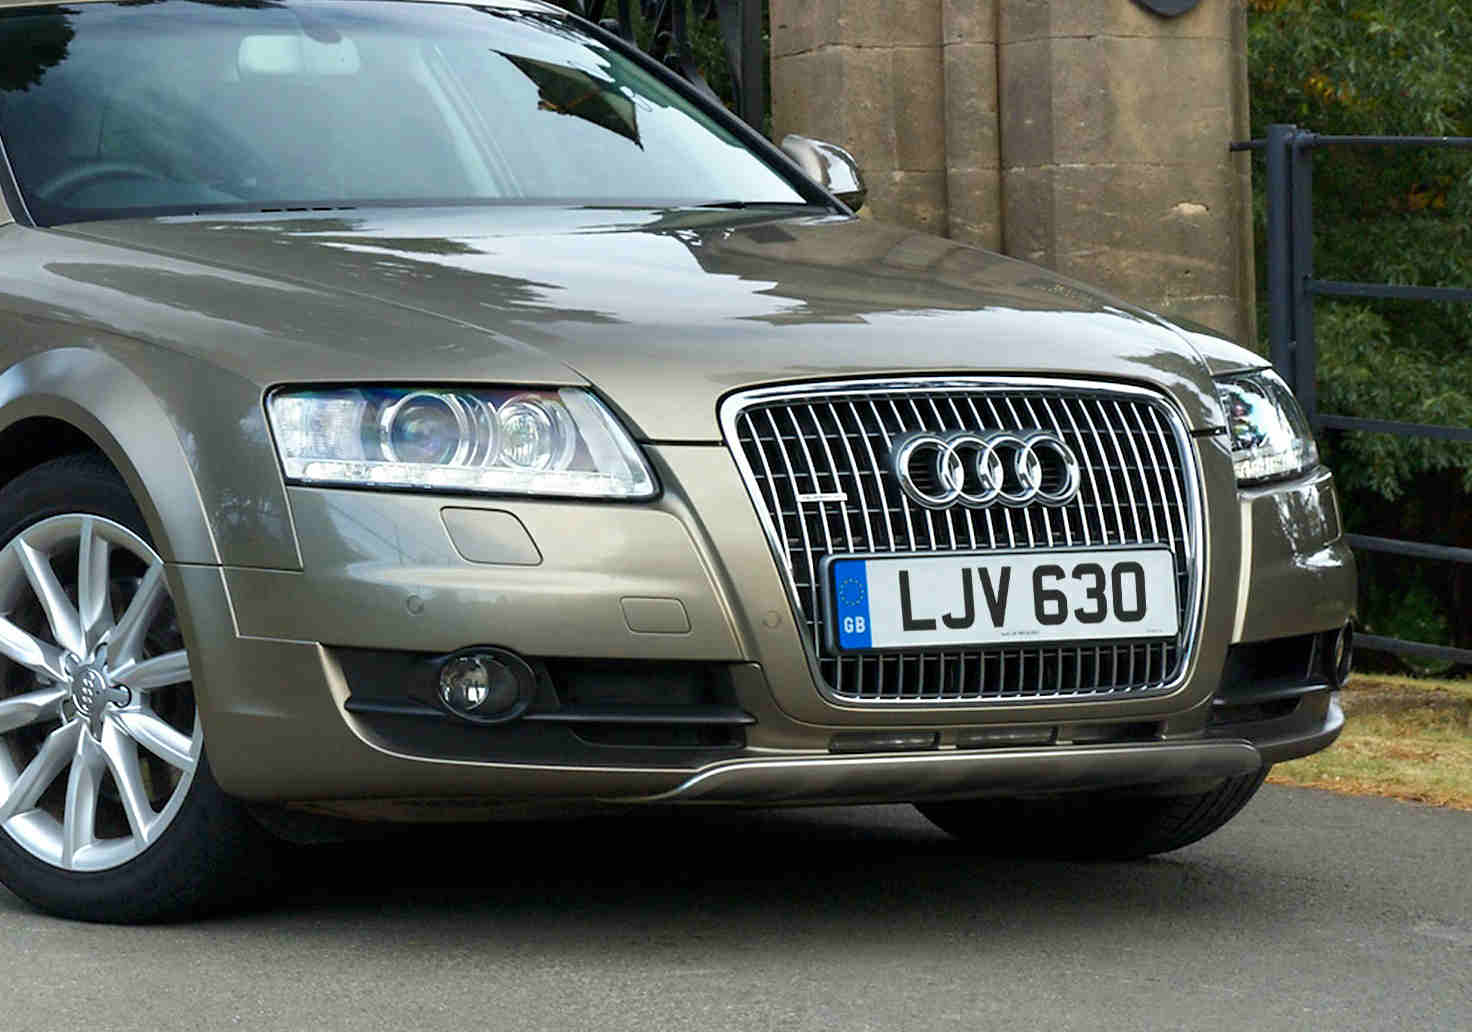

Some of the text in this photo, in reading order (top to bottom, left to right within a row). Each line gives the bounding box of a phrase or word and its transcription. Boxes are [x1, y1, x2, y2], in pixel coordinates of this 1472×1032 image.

[897, 560, 1148, 632] LJV 630
[843, 615, 866, 634] GB
